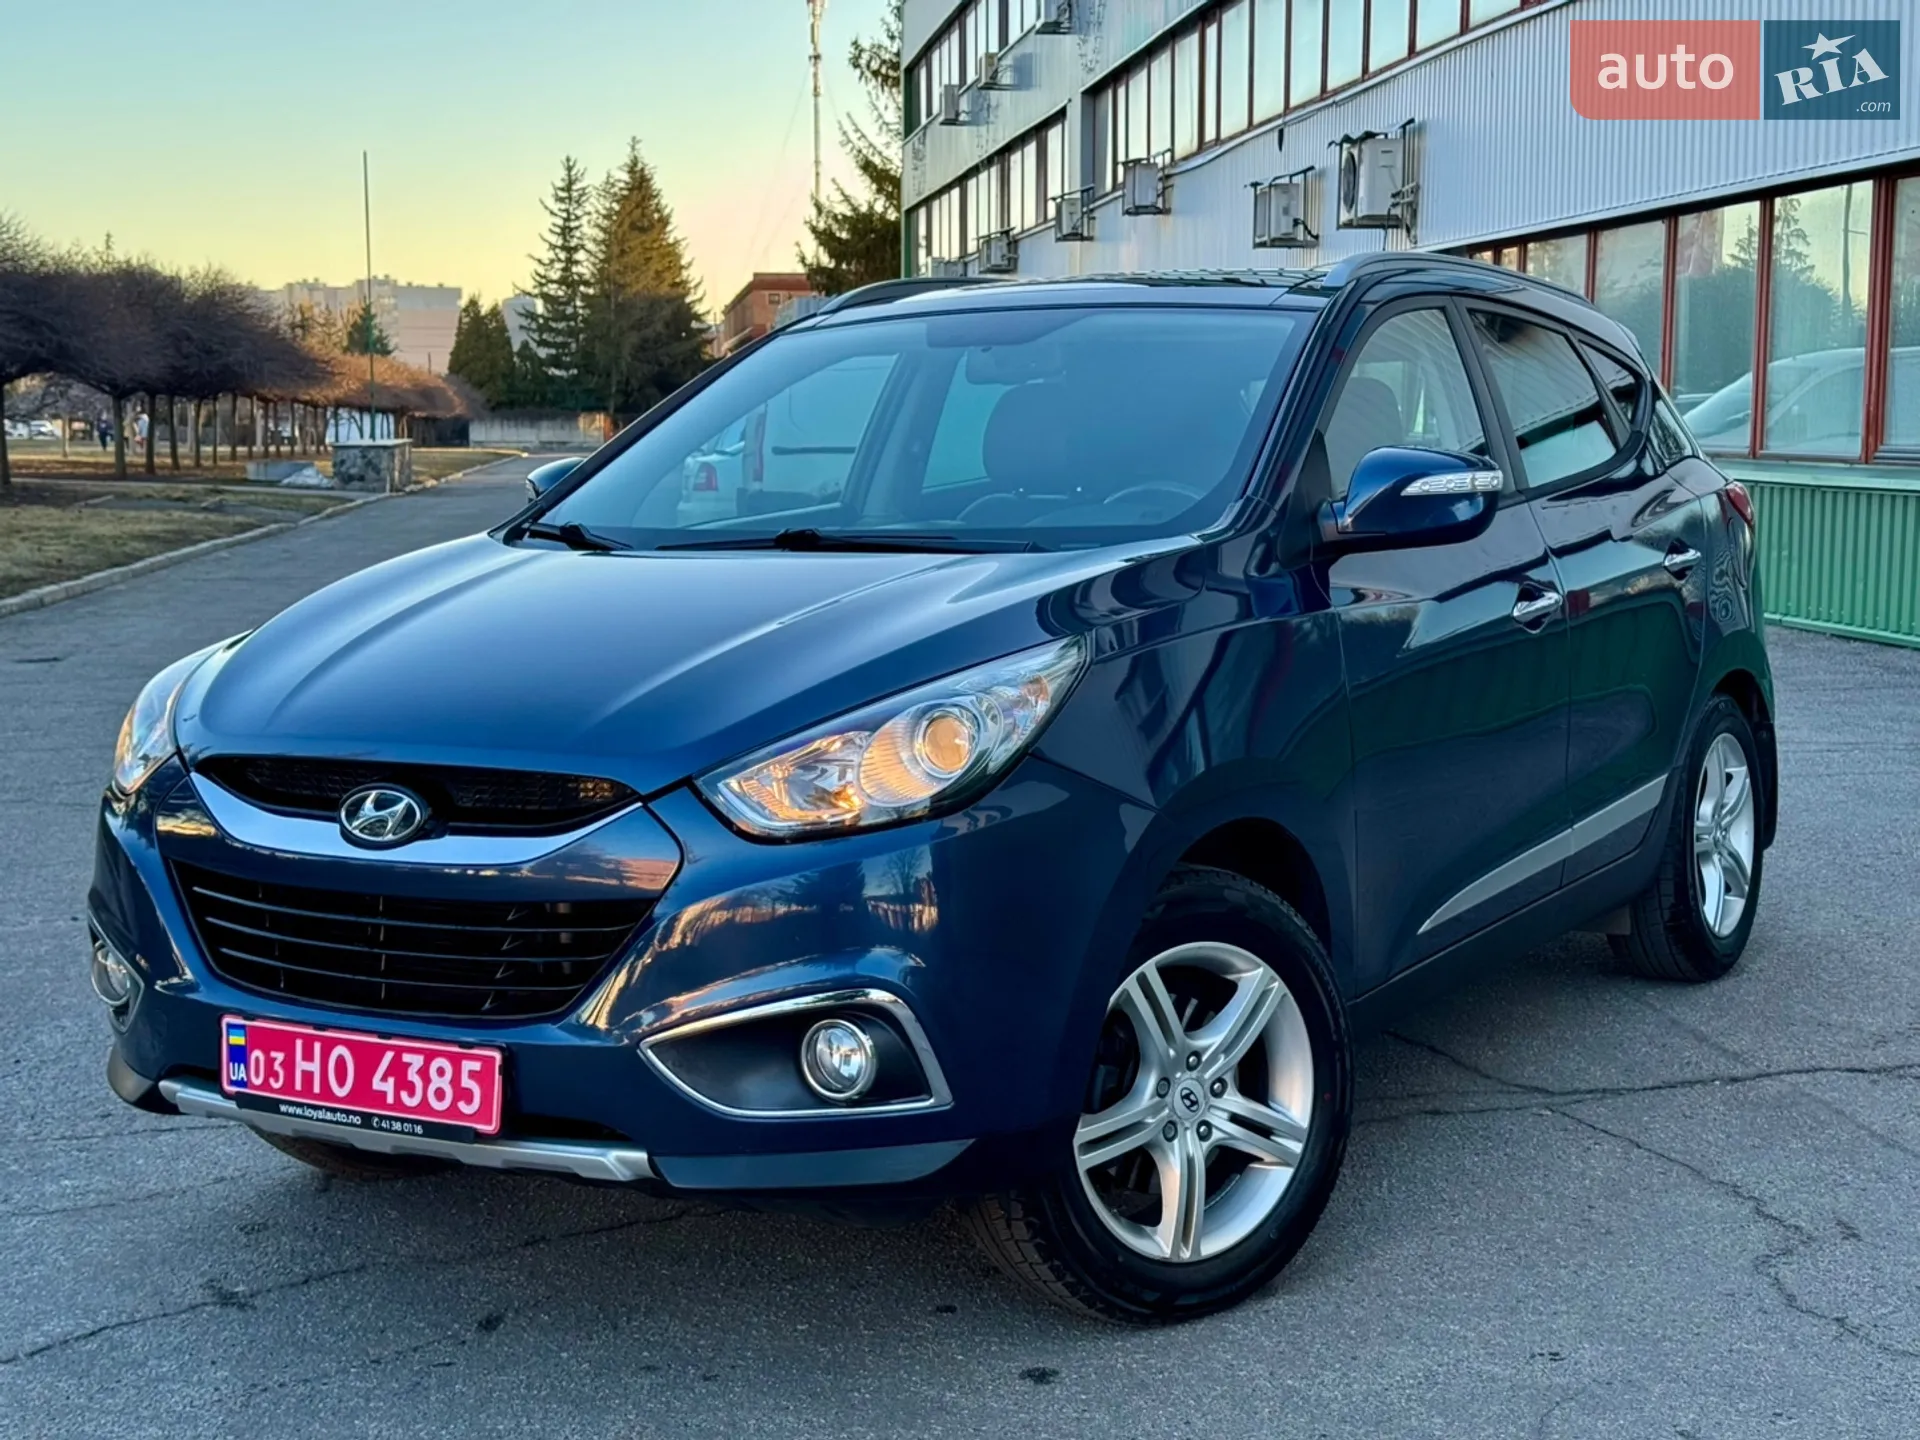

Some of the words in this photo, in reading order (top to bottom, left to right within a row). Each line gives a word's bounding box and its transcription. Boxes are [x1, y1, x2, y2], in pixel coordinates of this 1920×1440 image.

[229, 1062, 247, 1082] UA
[250, 1049, 285, 1089] 03
[294, 1038, 355, 1098] HO
[372, 1050, 482, 1115] 4385
[279, 1103, 362, 1125] www.loyalauto.no
